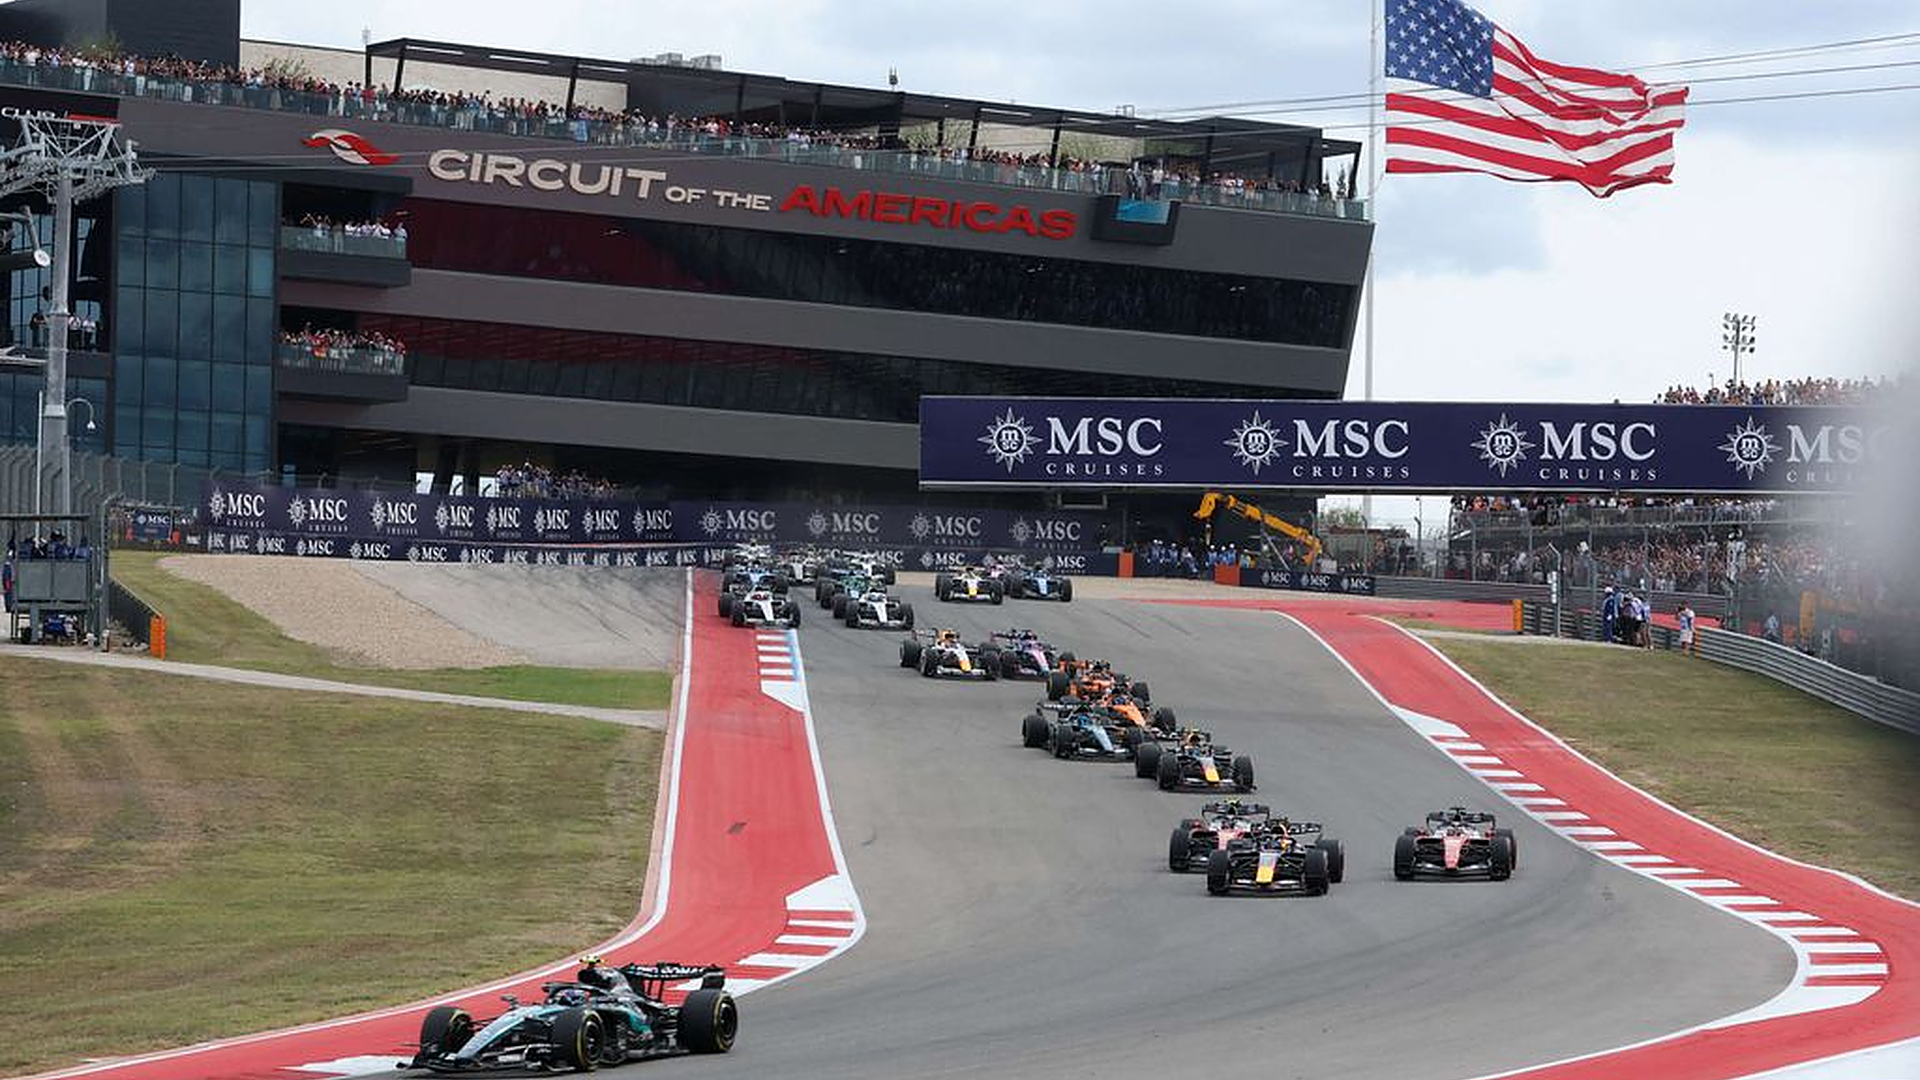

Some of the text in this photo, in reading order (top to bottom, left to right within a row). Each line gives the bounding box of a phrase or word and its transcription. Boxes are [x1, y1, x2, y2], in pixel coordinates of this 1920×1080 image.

[428, 149, 1080, 240] CIRCUIT OF THE AMERICAS
[1046, 417, 1162, 455] MSC
[1293, 419, 1409, 458] MSC
[1539, 422, 1655, 460] MSC
[1786, 424, 1890, 463] MS
[1046, 463, 1163, 475] CRUISES
[1293, 466, 1409, 478] CRUISES
[1539, 468, 1656, 480] CRUISES
[227, 492, 265, 517] MSC
[309, 499, 348, 521] MSC
[386, 502, 418, 524] MSC
[450, 506, 475, 528] MSC
[498, 507, 520, 528] MSC
[546, 509, 570, 530] MSC
[595, 510, 620, 530] MSC
[646, 510, 672, 530] MSC
[726, 510, 776, 531] MSC
[831, 513, 880, 533] MSC
[935, 515, 981, 537] MSC
[1035, 520, 1081, 541] MSC
[308, 540, 334, 555] MSC
[363, 543, 390, 558] MSC
[422, 546, 448, 561] MSC
[471, 549, 494, 564] MSC
[935, 552, 965, 565] MSC
[1056, 556, 1086, 568] MSC
